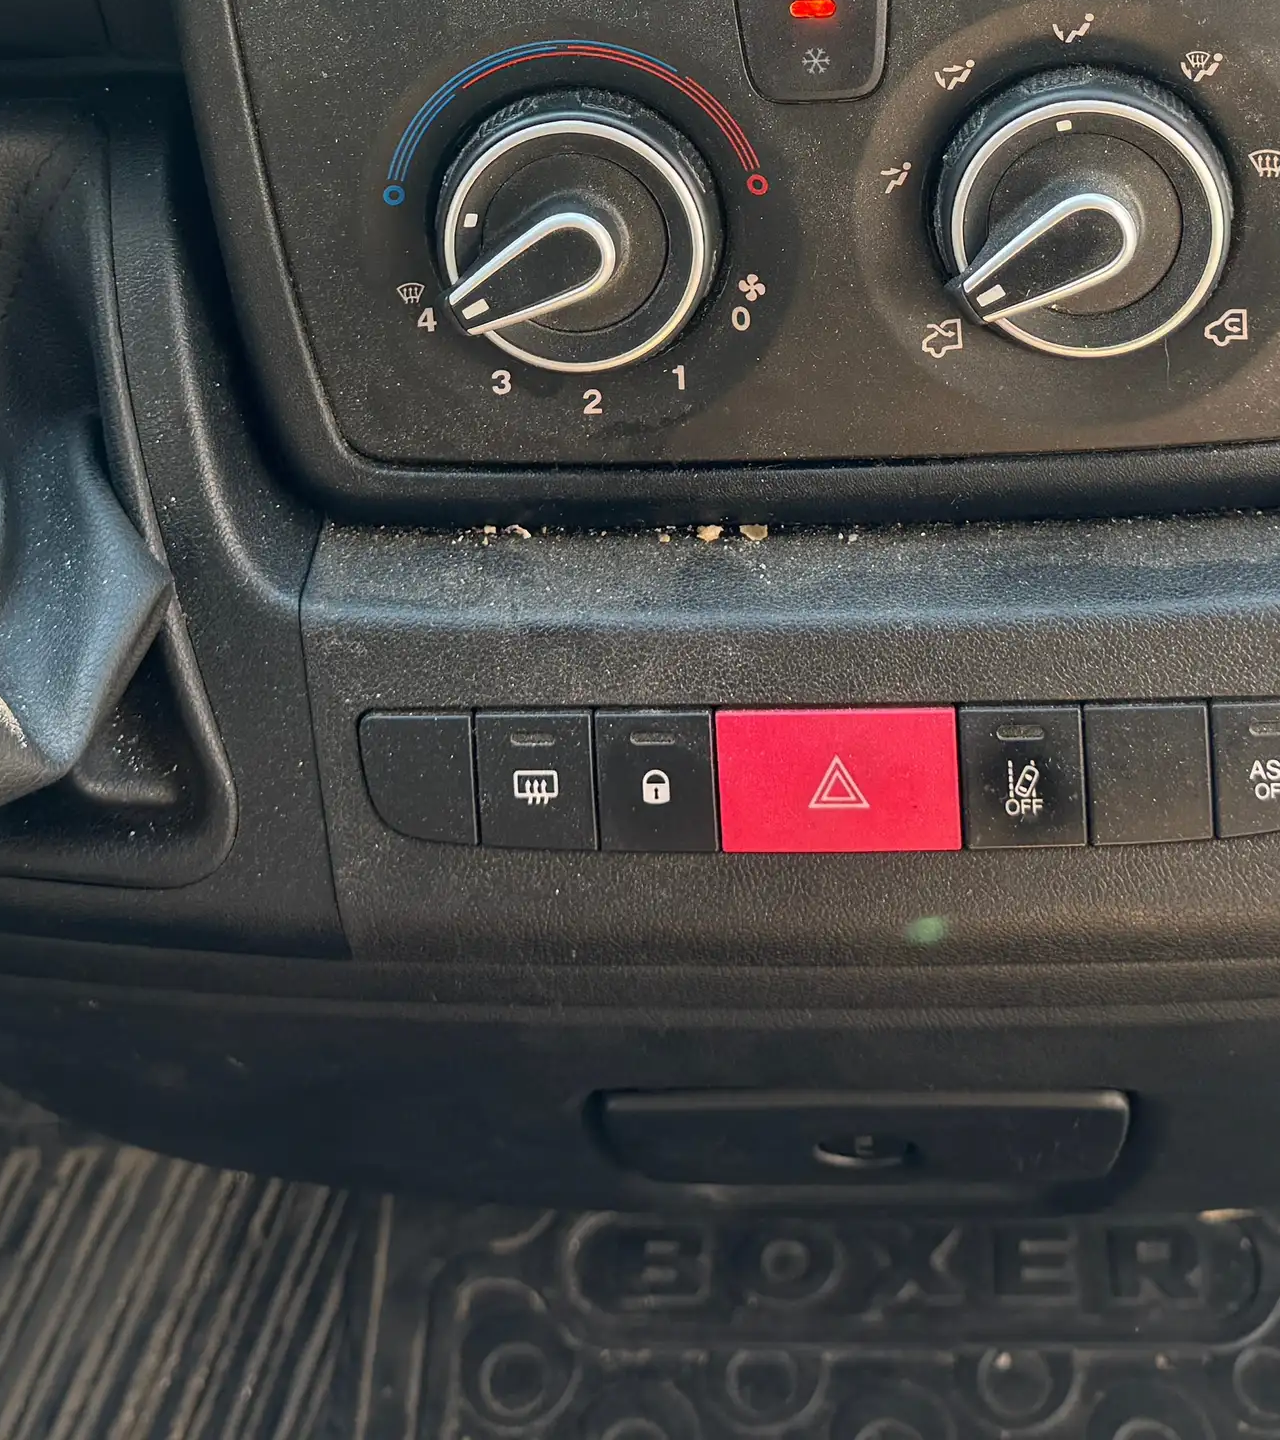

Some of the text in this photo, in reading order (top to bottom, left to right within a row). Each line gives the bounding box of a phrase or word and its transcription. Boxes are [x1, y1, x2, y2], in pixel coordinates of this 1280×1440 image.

[417, 308, 437, 332] 4
[731, 306, 751, 330] 0
[491, 370, 512, 395] 3
[673, 365, 686, 390] 1
[583, 389, 603, 414] 2
[1004, 797, 1045, 818] OFF
[628, 1228, 1216, 1312] BOXER
